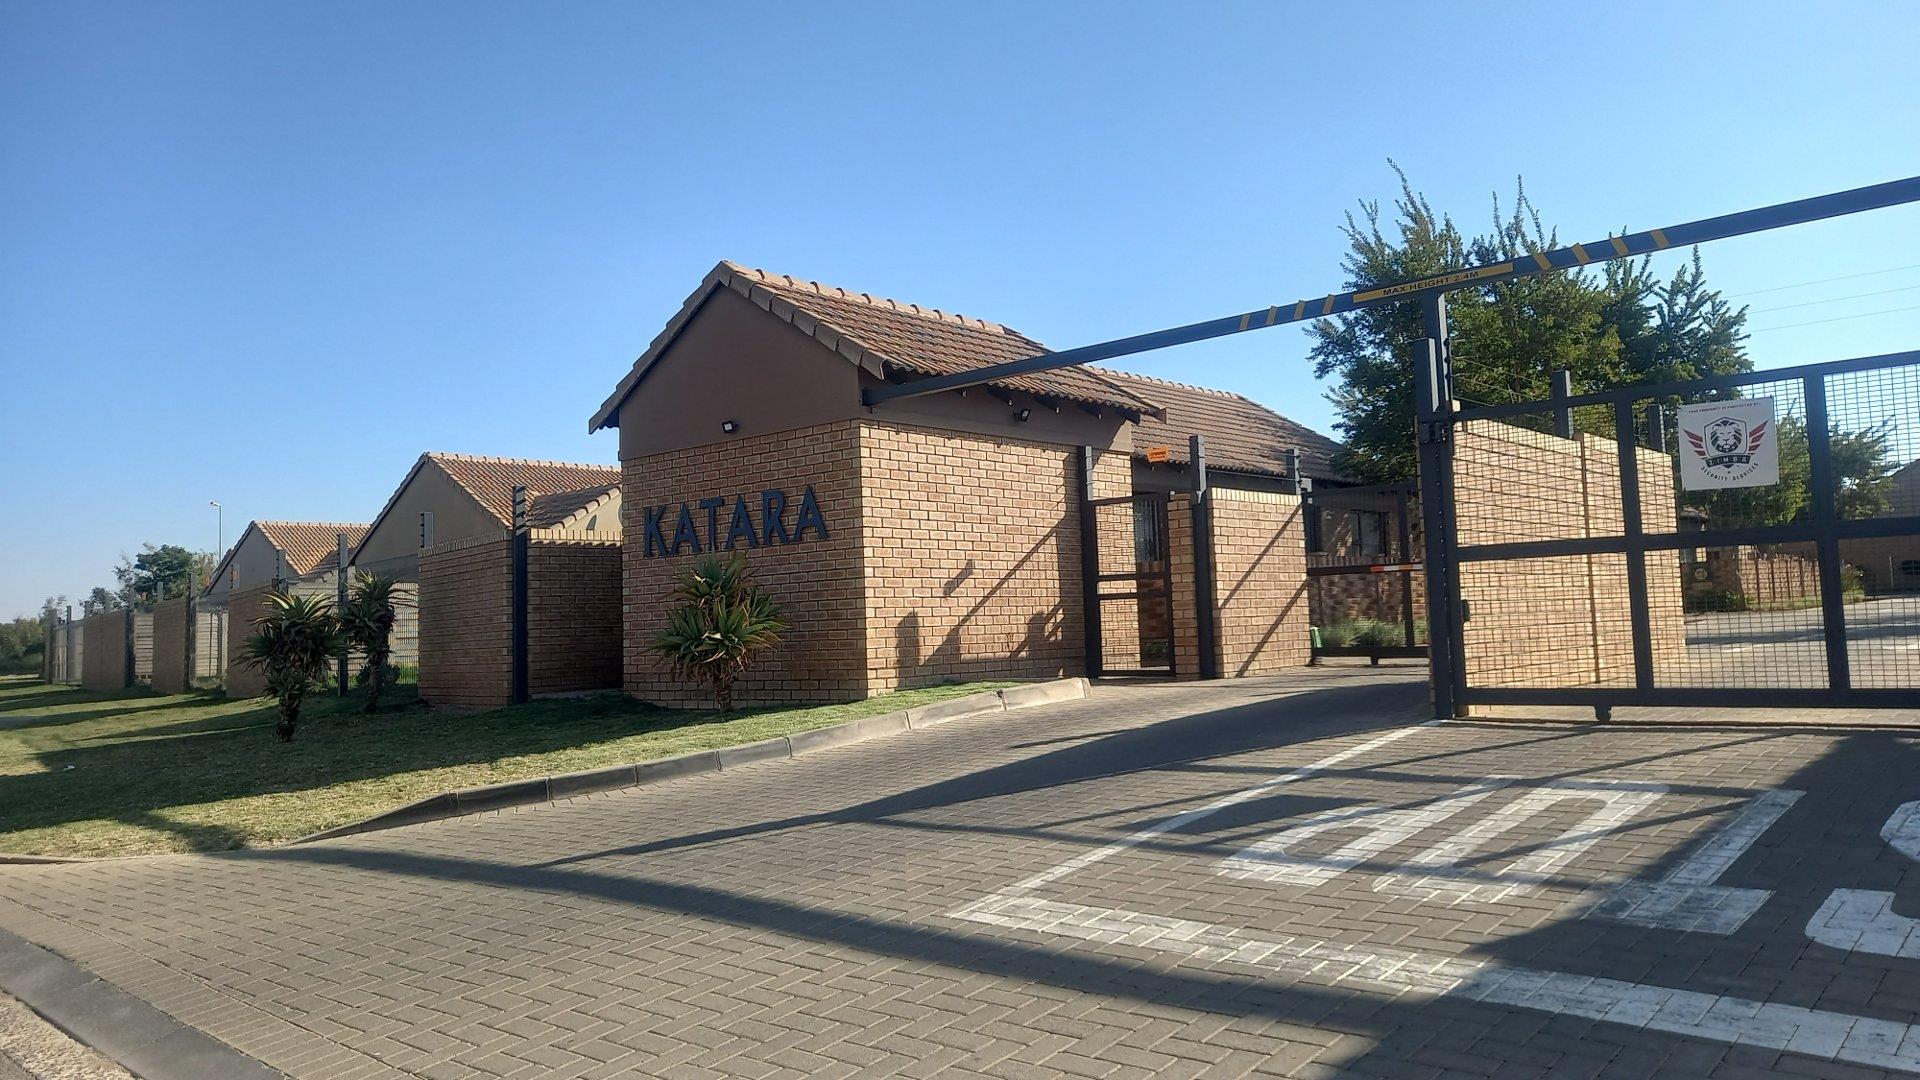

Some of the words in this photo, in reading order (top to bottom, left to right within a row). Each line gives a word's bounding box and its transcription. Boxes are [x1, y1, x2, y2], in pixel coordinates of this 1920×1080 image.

[1383, 287, 1406, 296] MAX
[1409, 278, 1449, 290] HEIGHT
[1708, 456, 1747, 466] ZIMBA
[1701, 466, 1728, 481] SECURITY
[643, 485, 829, 558] KATARA
